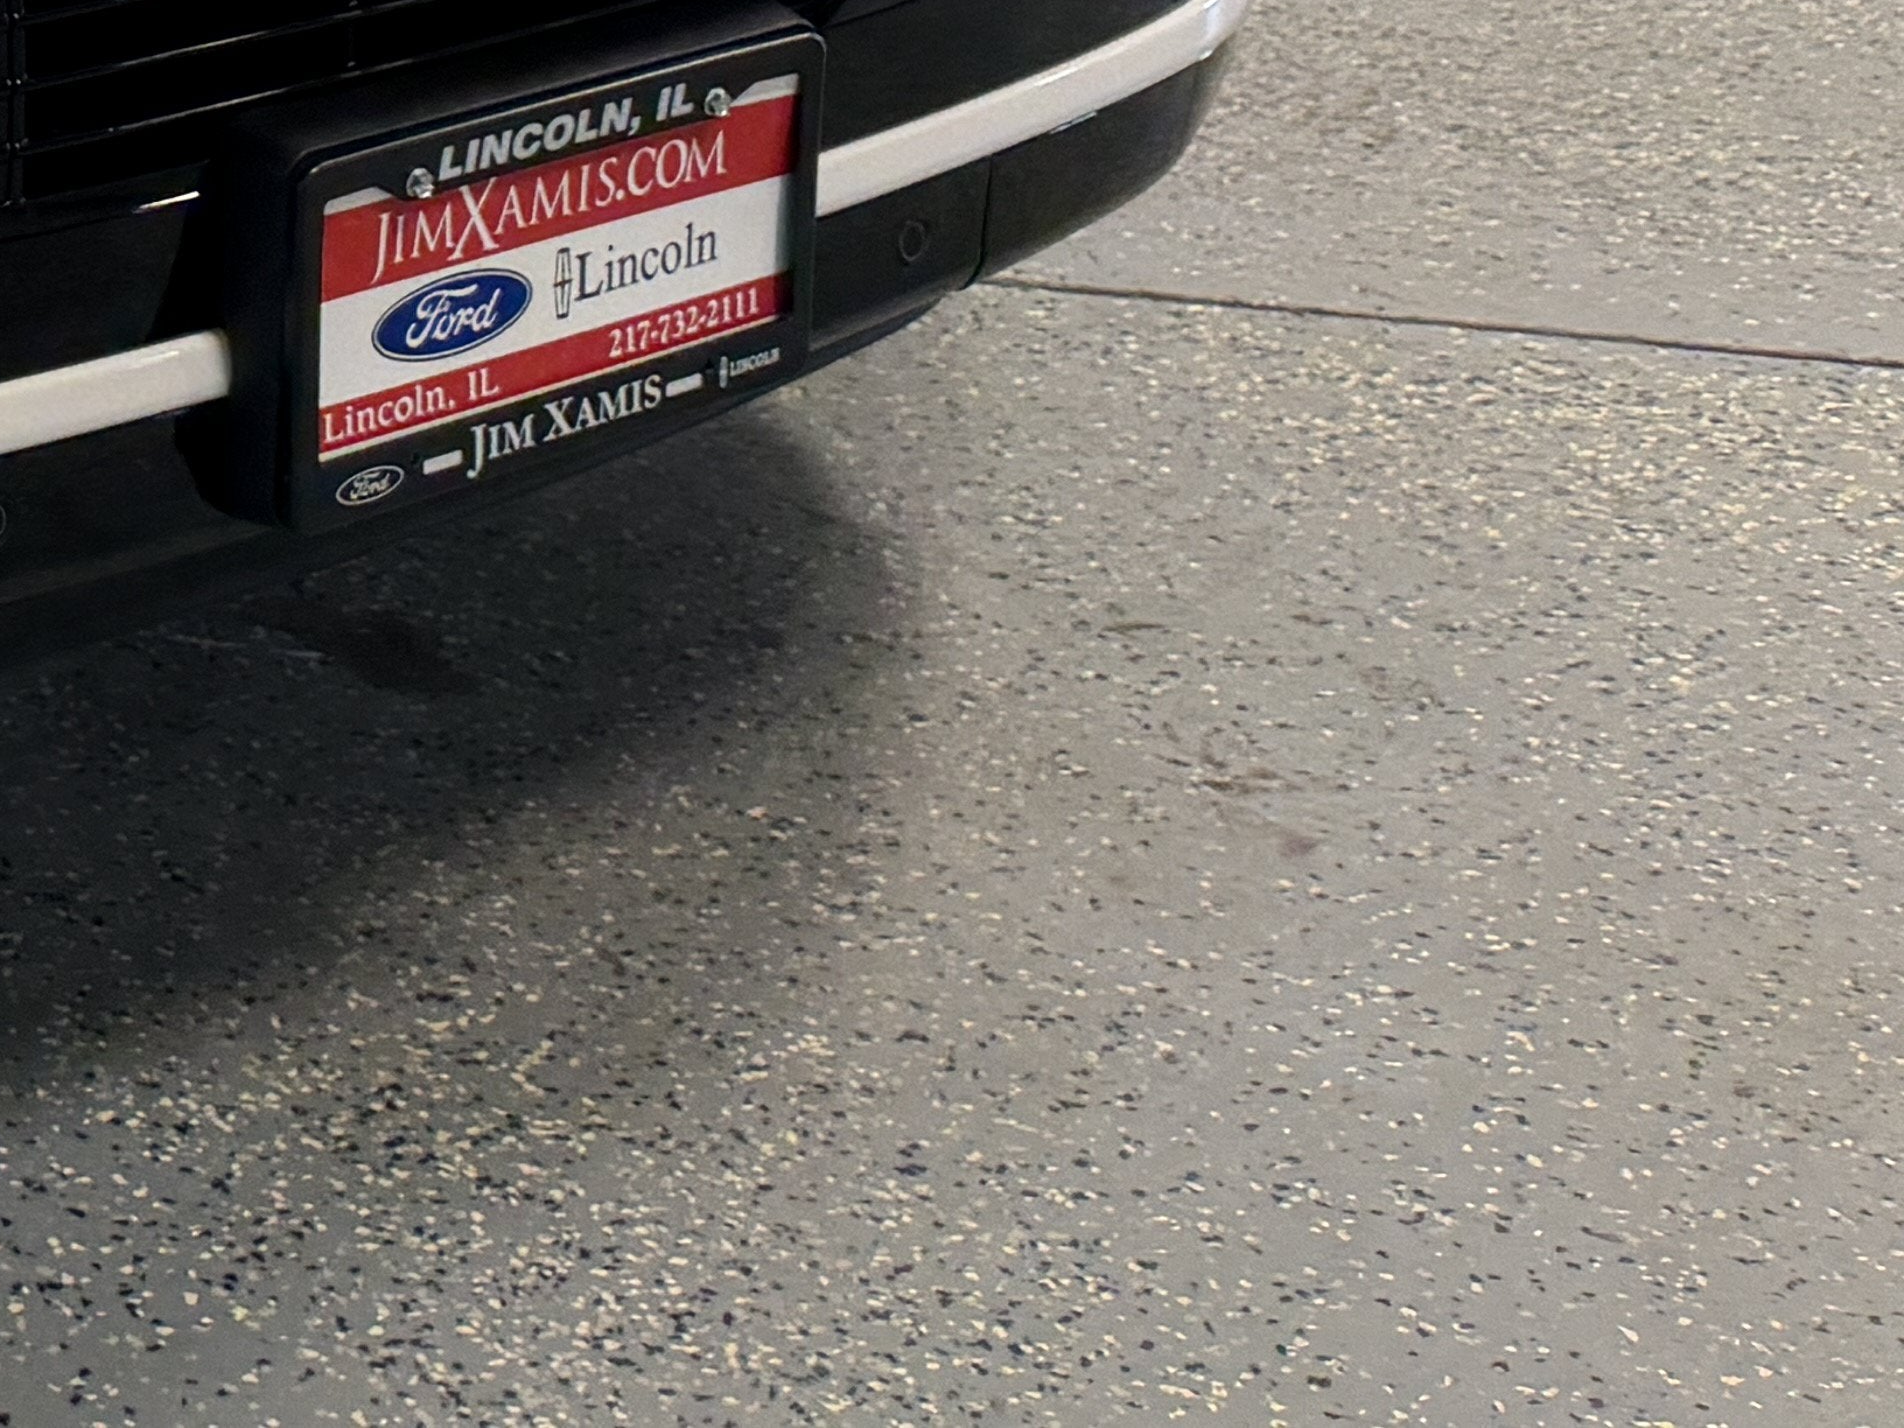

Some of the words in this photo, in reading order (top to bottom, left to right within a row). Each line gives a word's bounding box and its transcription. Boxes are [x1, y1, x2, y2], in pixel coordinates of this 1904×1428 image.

[438, 97, 639, 181] LINCOLN,
[656, 82, 694, 121] IL
[370, 130, 728, 284] JIMXAMIS.COM
[573, 222, 717, 302] Lincoln
[406, 285, 498, 348] Ford
[608, 288, 760, 359] 217-732-2111
[466, 412, 536, 479] JIM
[542, 373, 663, 441] XAMIS
[467, 368, 500, 404] IL
